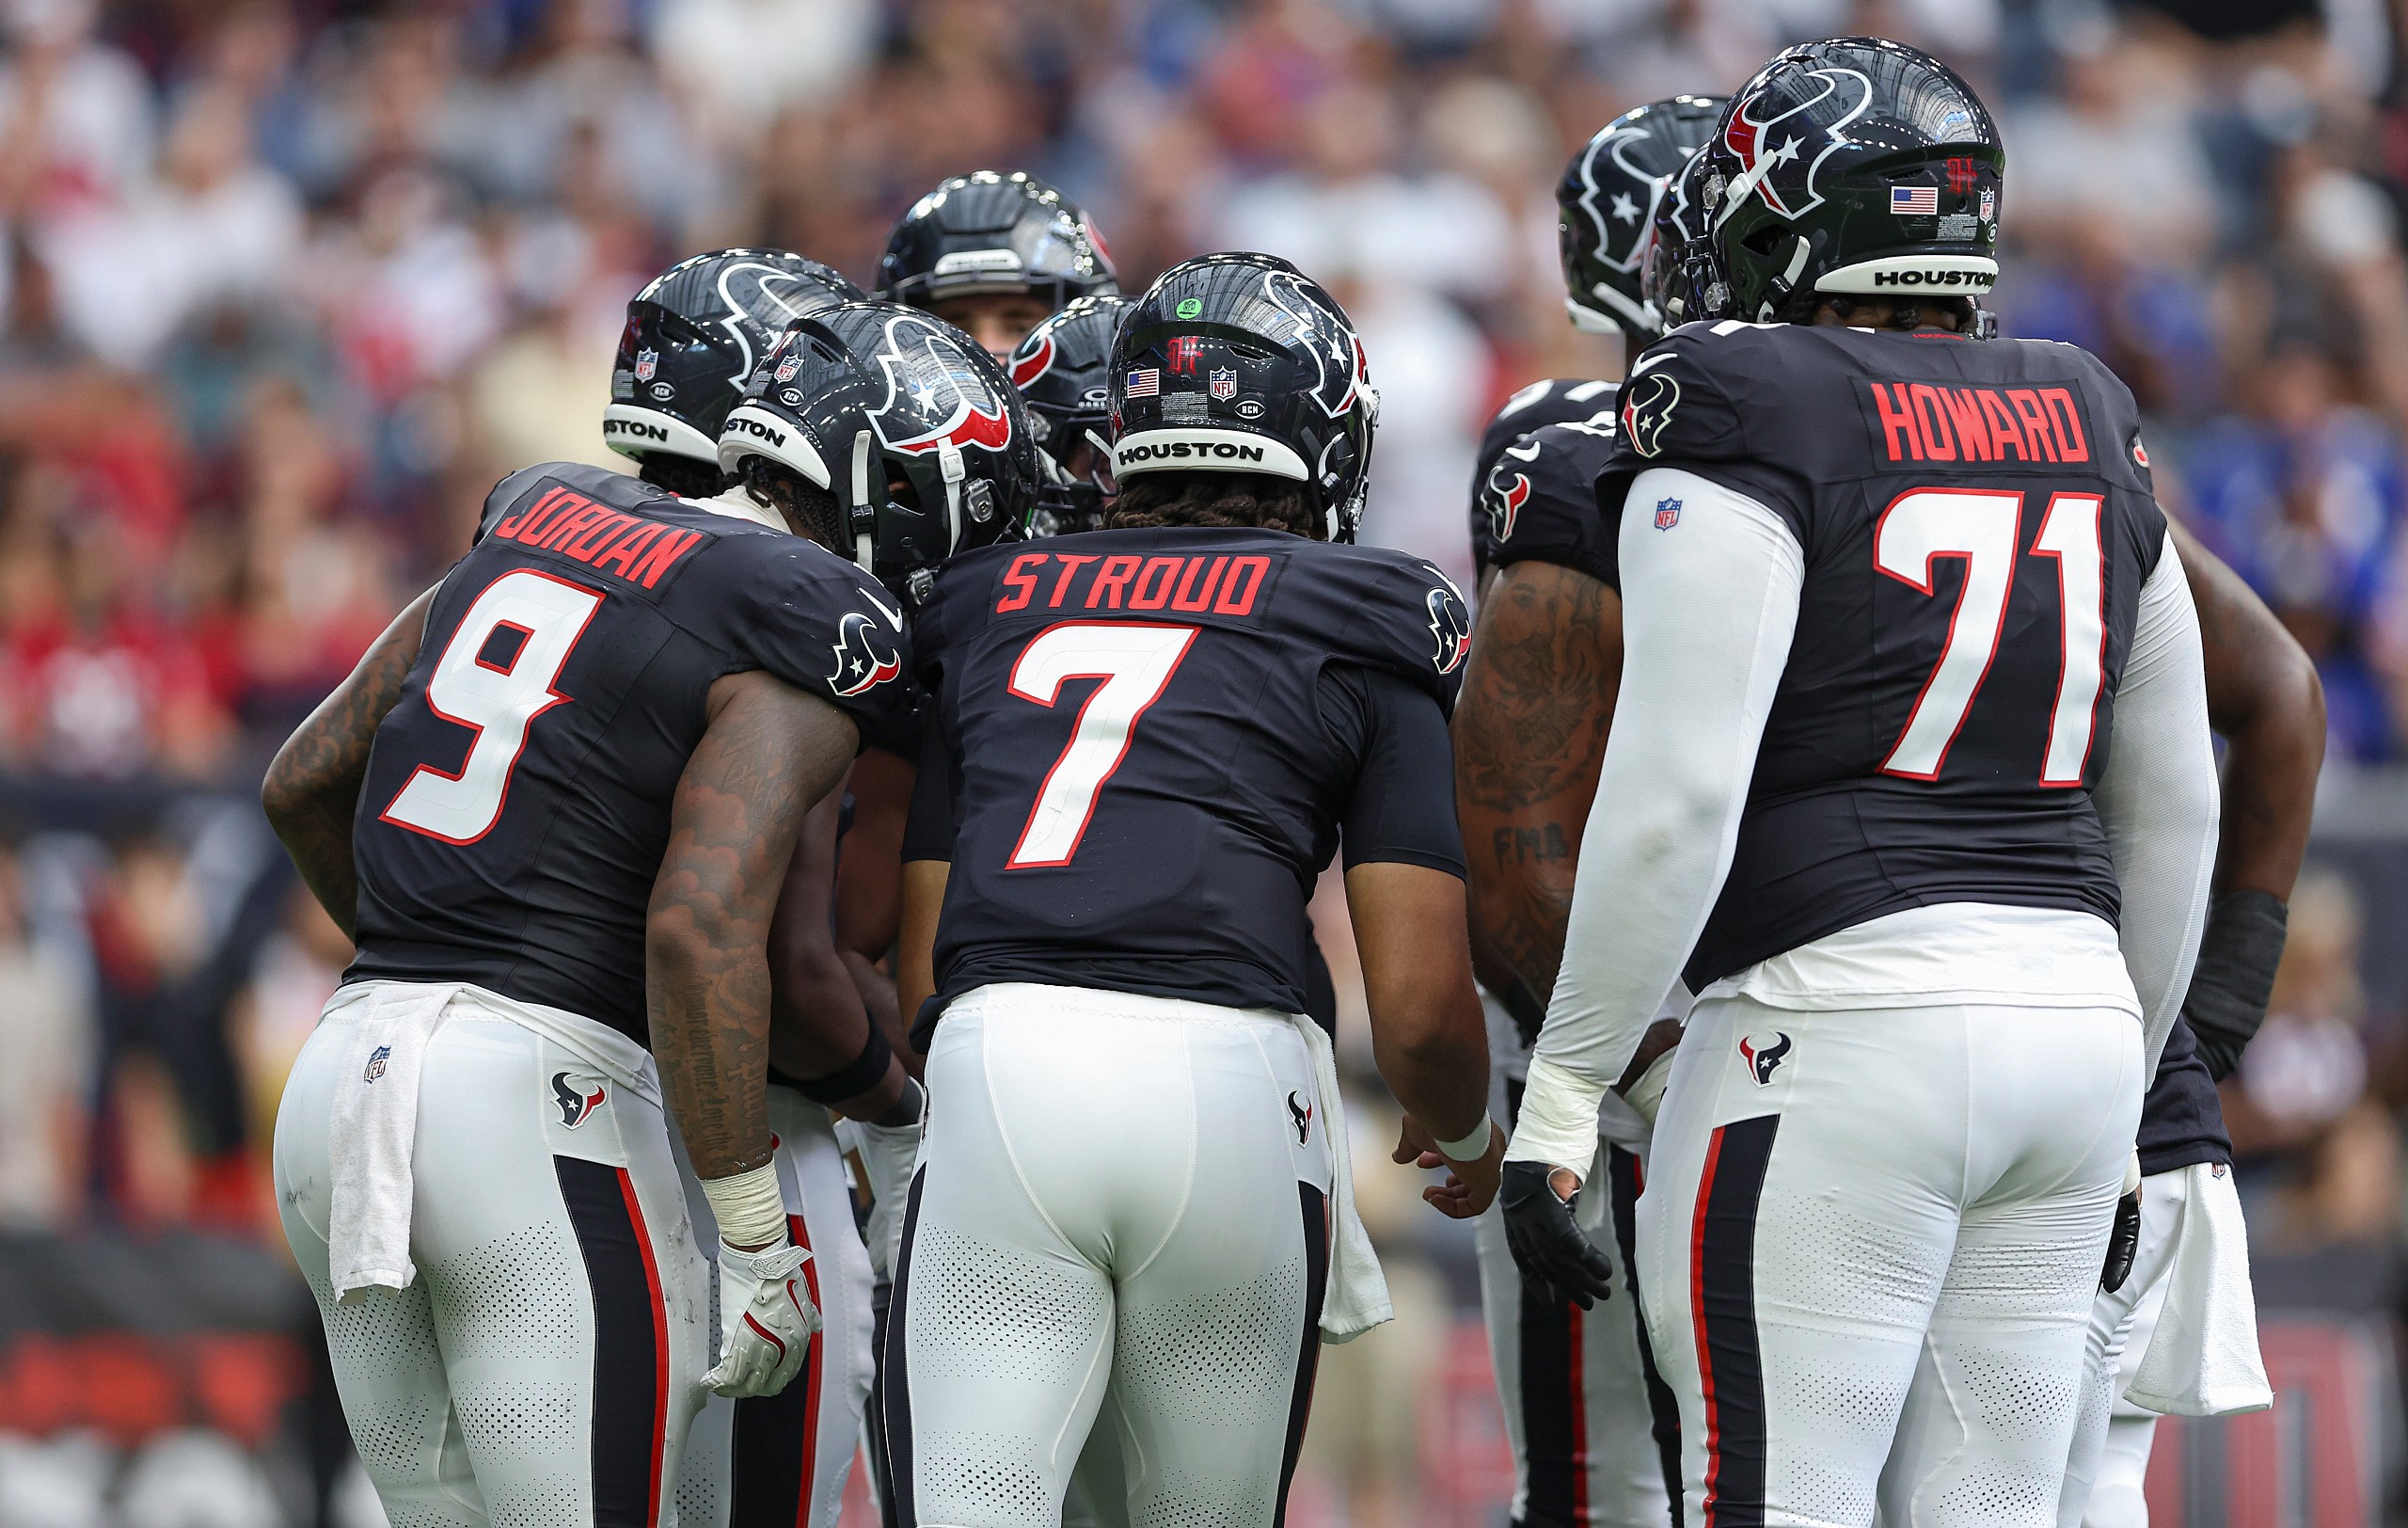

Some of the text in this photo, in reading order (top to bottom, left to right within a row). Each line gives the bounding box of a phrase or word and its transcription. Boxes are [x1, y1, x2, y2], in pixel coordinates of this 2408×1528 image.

[1874, 270, 1997, 287] HOUSTON
[638, 362, 652, 377] NFL
[778, 365, 794, 380] NFL
[1213, 381, 1233, 395] NFL
[1871, 382, 2089, 463] HOWARD
[1117, 442, 1264, 466] HOUSTON
[495, 485, 703, 590] JORDAN
[1656, 511, 1677, 527] NFL
[996, 553, 1271, 616] STROUD
[1872, 486, 2105, 788] 71
[378, 567, 575, 846] 9
[1004, 619, 1202, 870] 7
